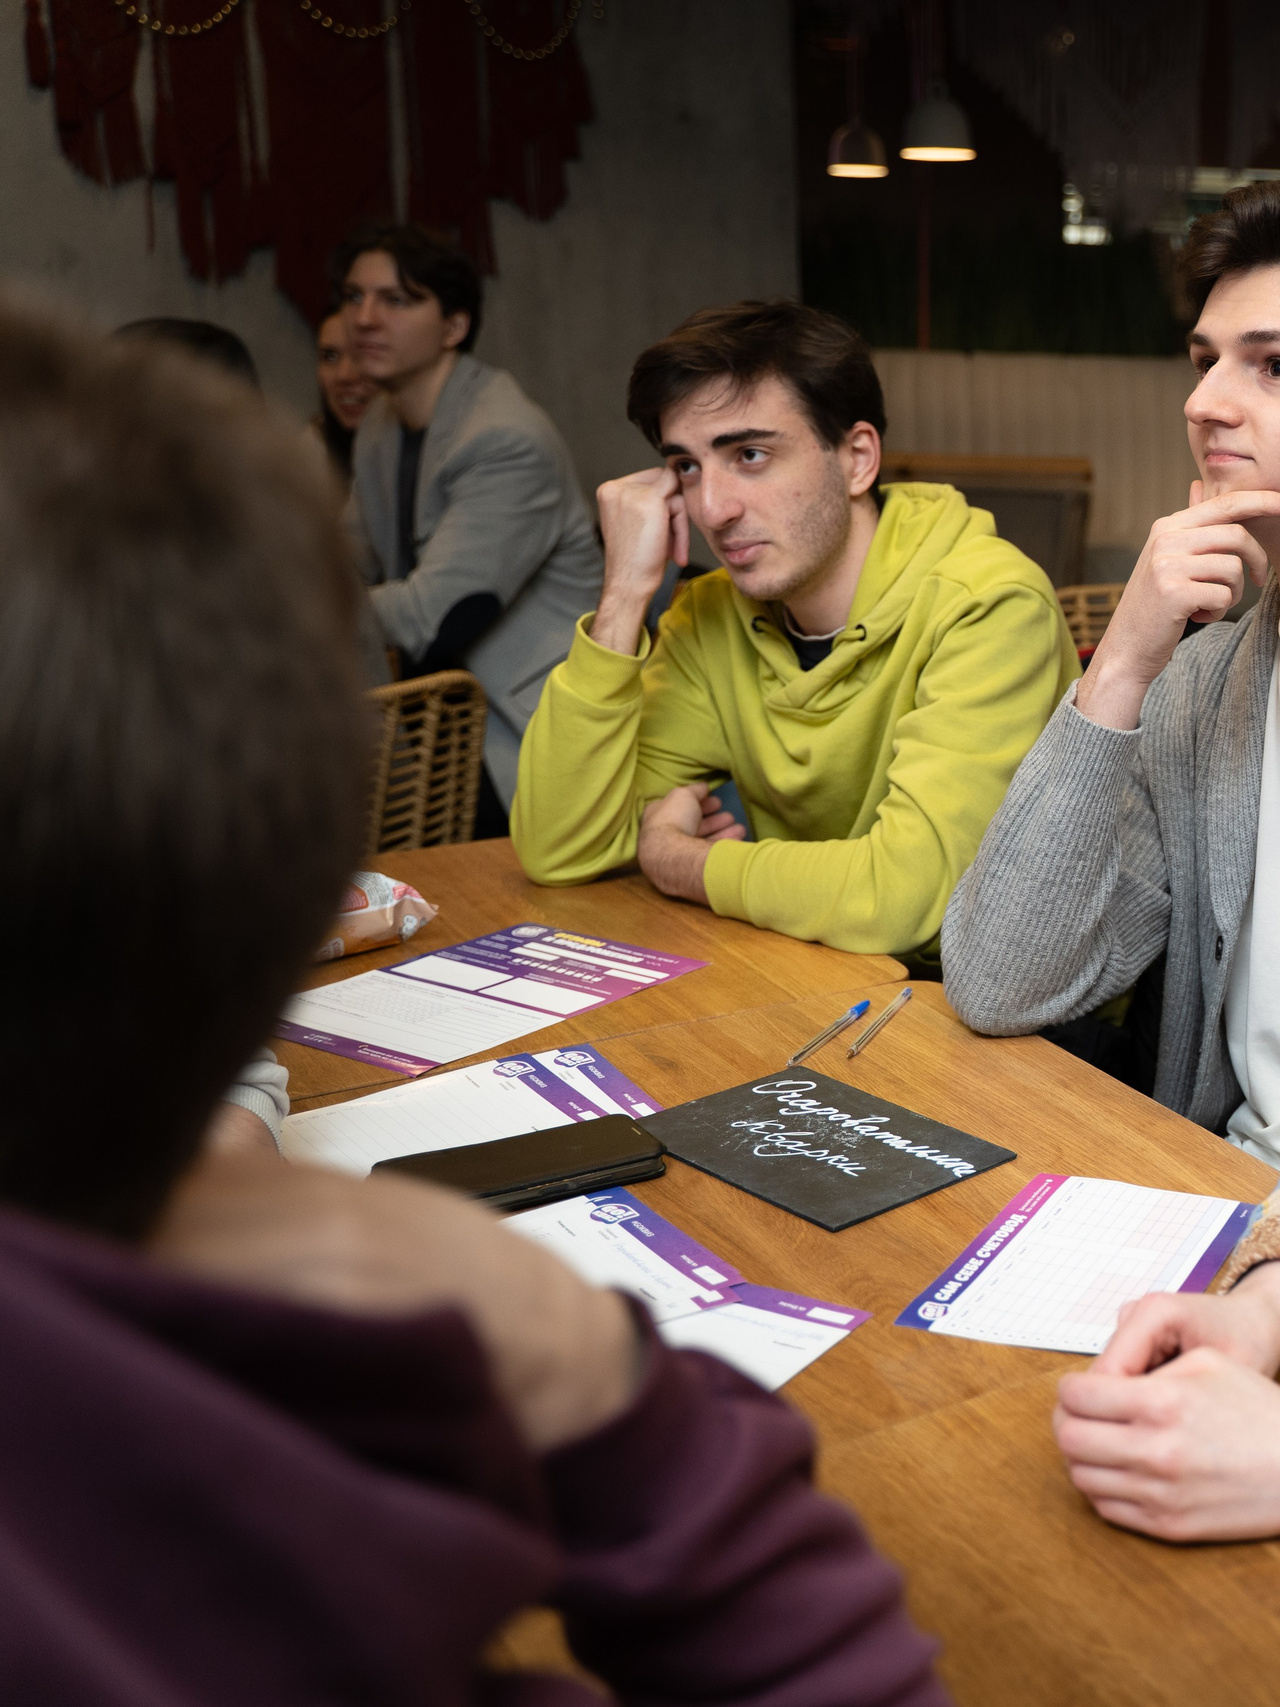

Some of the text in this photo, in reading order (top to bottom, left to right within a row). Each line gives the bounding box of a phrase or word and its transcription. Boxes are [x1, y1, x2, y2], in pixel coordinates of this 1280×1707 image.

[934, 1213, 1028, 1301] САМ СЕБЕ СЧЕТОВОД
